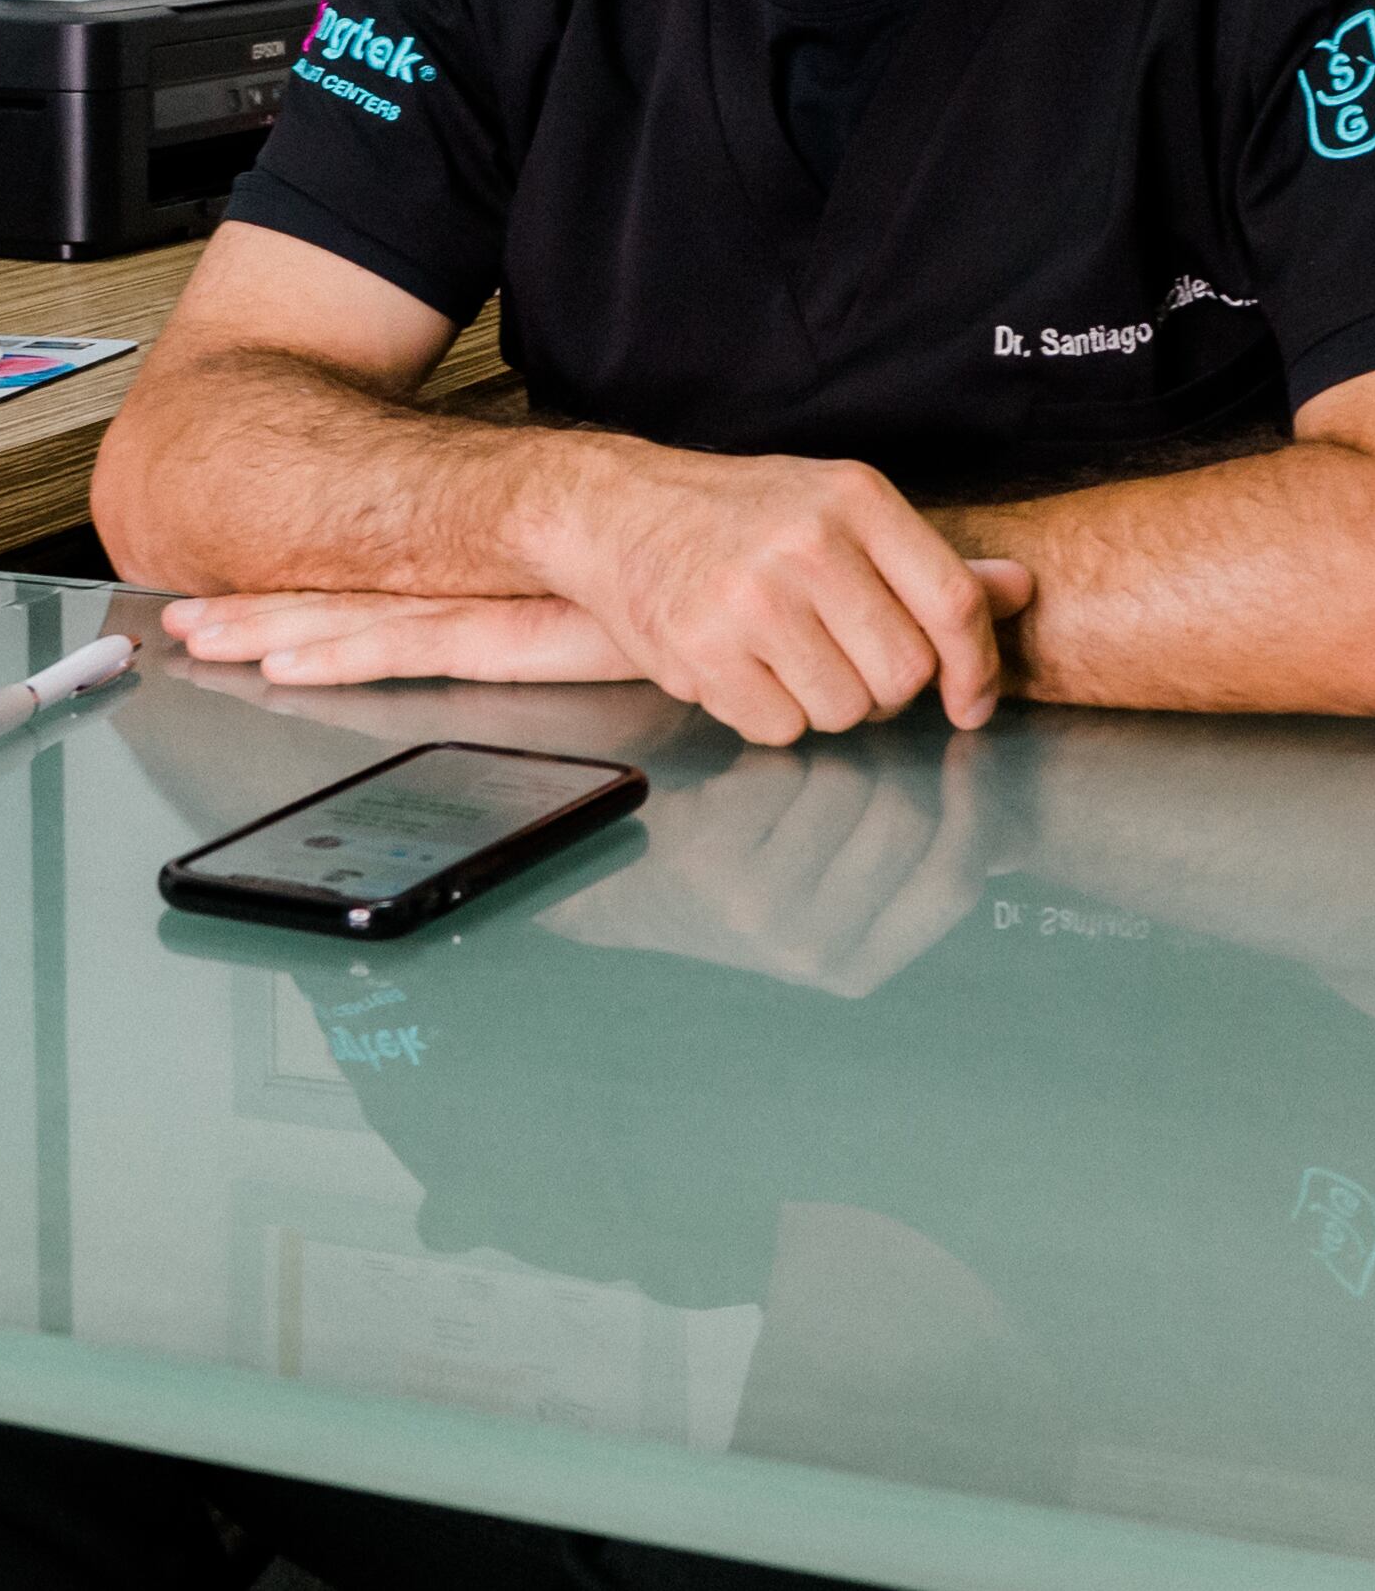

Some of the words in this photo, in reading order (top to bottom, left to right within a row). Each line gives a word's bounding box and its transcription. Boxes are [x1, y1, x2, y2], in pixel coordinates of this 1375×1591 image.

[321, 74, 402, 122] CENTERS
[993, 324, 1032, 358] Dr.
[1039, 321, 1154, 355] Santiago
